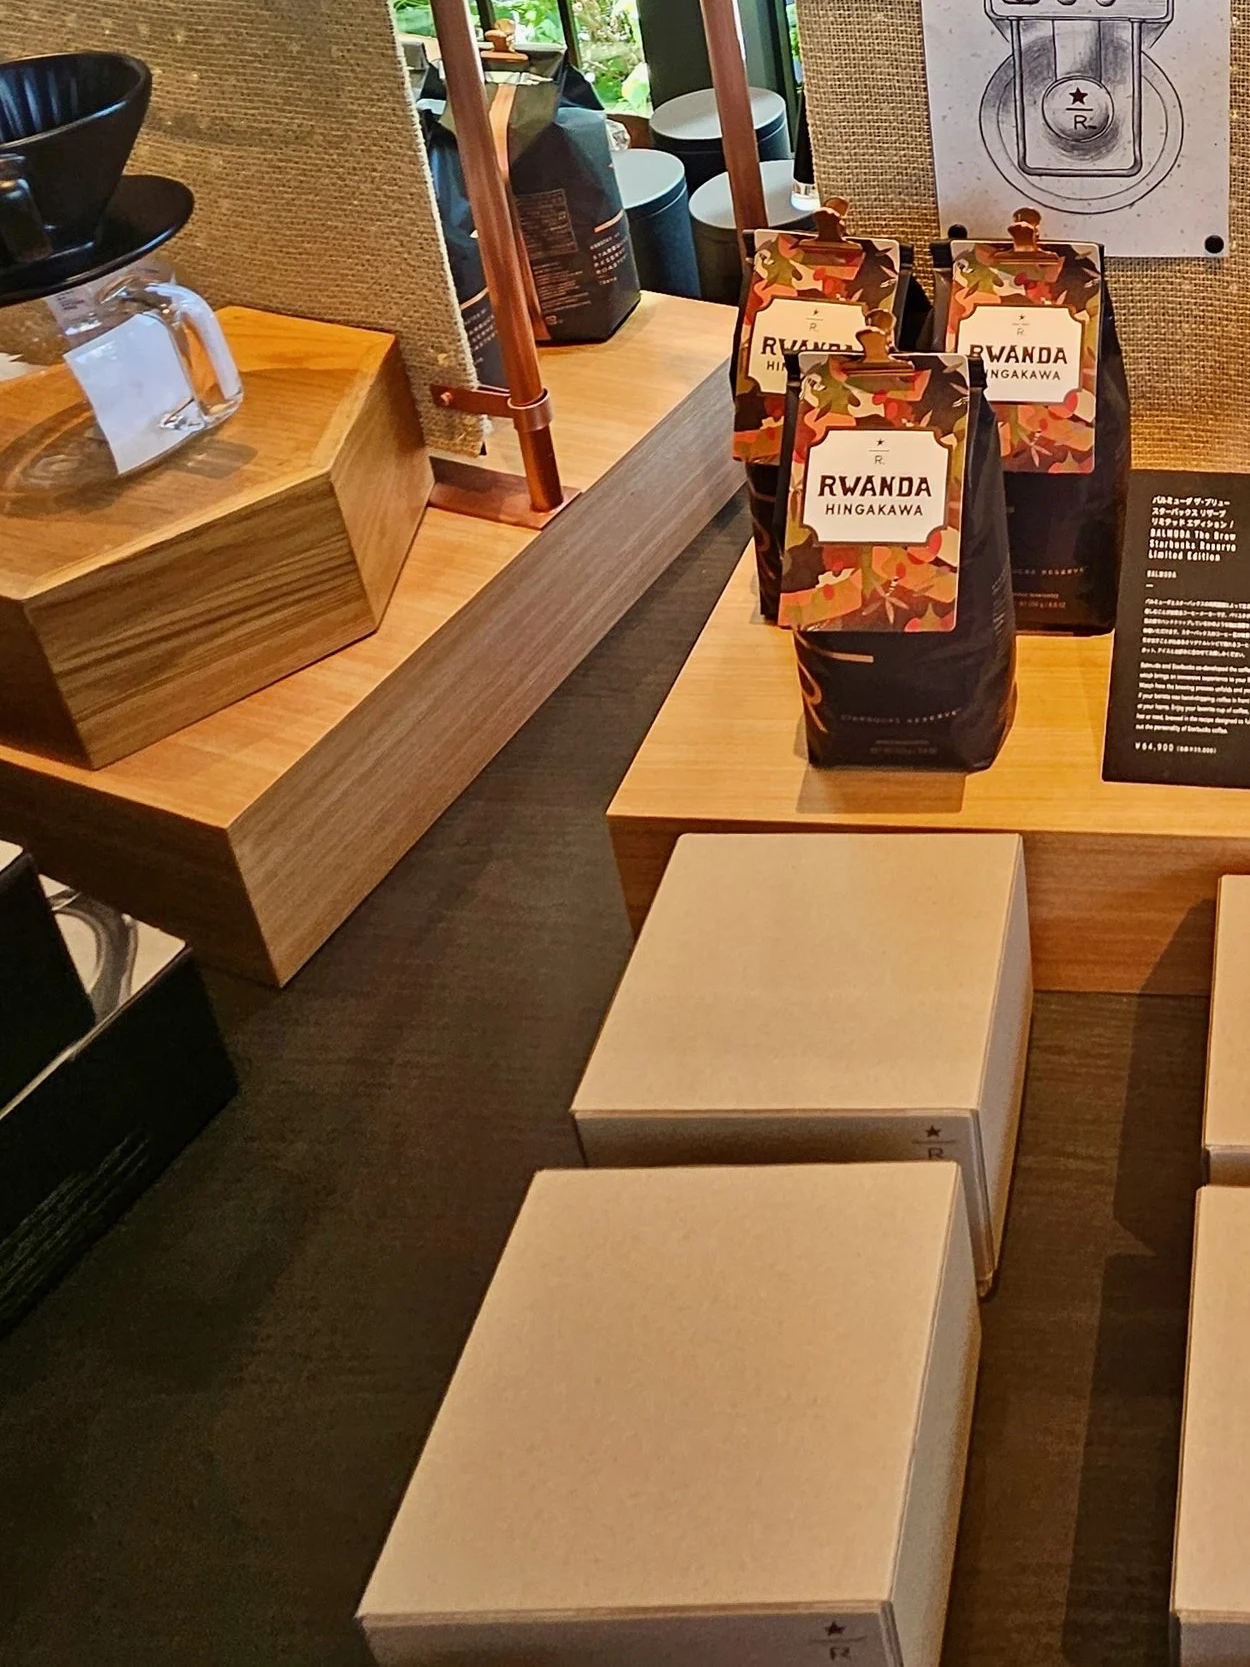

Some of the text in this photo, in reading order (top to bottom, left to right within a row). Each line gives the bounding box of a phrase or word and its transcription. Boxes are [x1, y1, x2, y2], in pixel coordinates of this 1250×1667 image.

[986, 369, 1061, 380] NGAKAWA
[817, 474, 933, 498] RWANDA
[824, 503, 924, 517] HINGAKAWA
